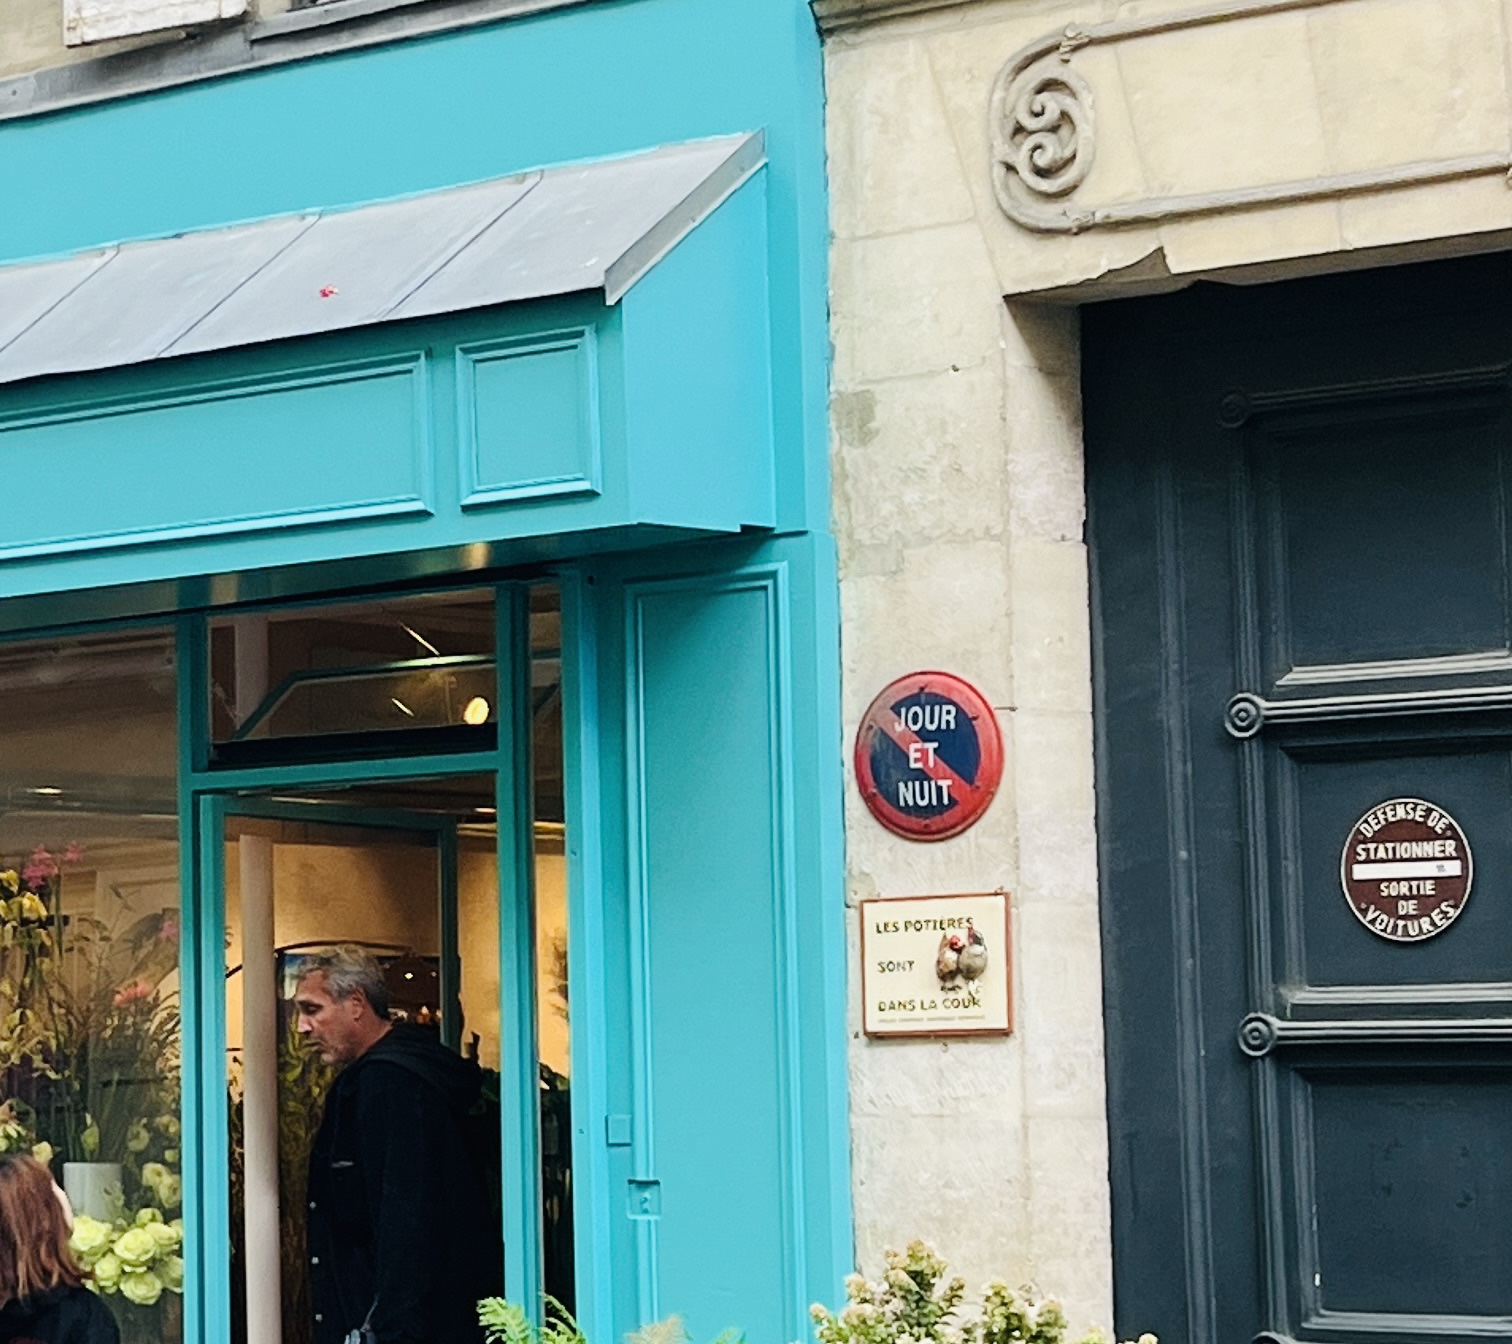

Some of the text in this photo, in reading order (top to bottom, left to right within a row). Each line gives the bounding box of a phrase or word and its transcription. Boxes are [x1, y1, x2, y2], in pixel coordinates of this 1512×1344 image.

[894, 704, 956, 732] JOUR
[909, 742, 939, 769] ET
[898, 779, 952, 807] NUIT
[1427, 811, 1450, 834] DE
[1356, 839, 1458, 861] STATIONNER
[1380, 880, 1436, 897] SORTIE
[1365, 901, 1456, 936] VOITURES
[1398, 900, 1418, 916] DE
[875, 920, 899, 934] LES
[877, 960, 915, 974] SONT
[878, 999, 916, 1012] DANS
[920, 999, 938, 1011] LA
